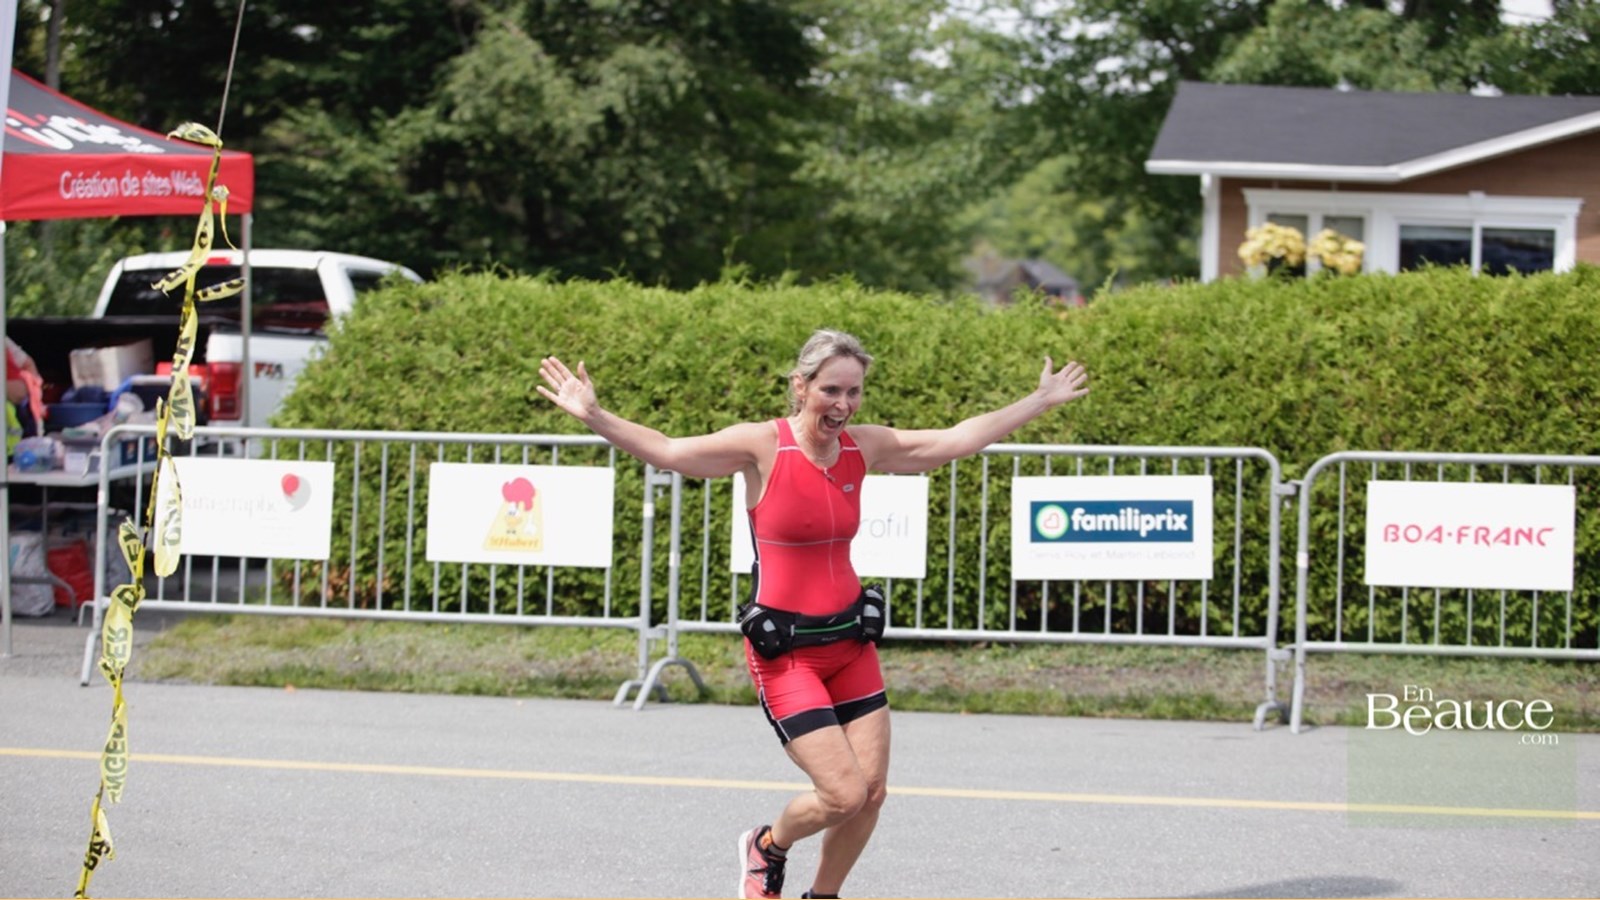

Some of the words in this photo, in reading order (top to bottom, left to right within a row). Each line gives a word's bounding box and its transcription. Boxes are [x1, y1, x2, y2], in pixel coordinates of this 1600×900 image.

[59, 171, 118, 199] Création
[120, 169, 140, 196] de
[859, 512, 909, 539] rofil
[1071, 507, 1188, 538] familiprix
